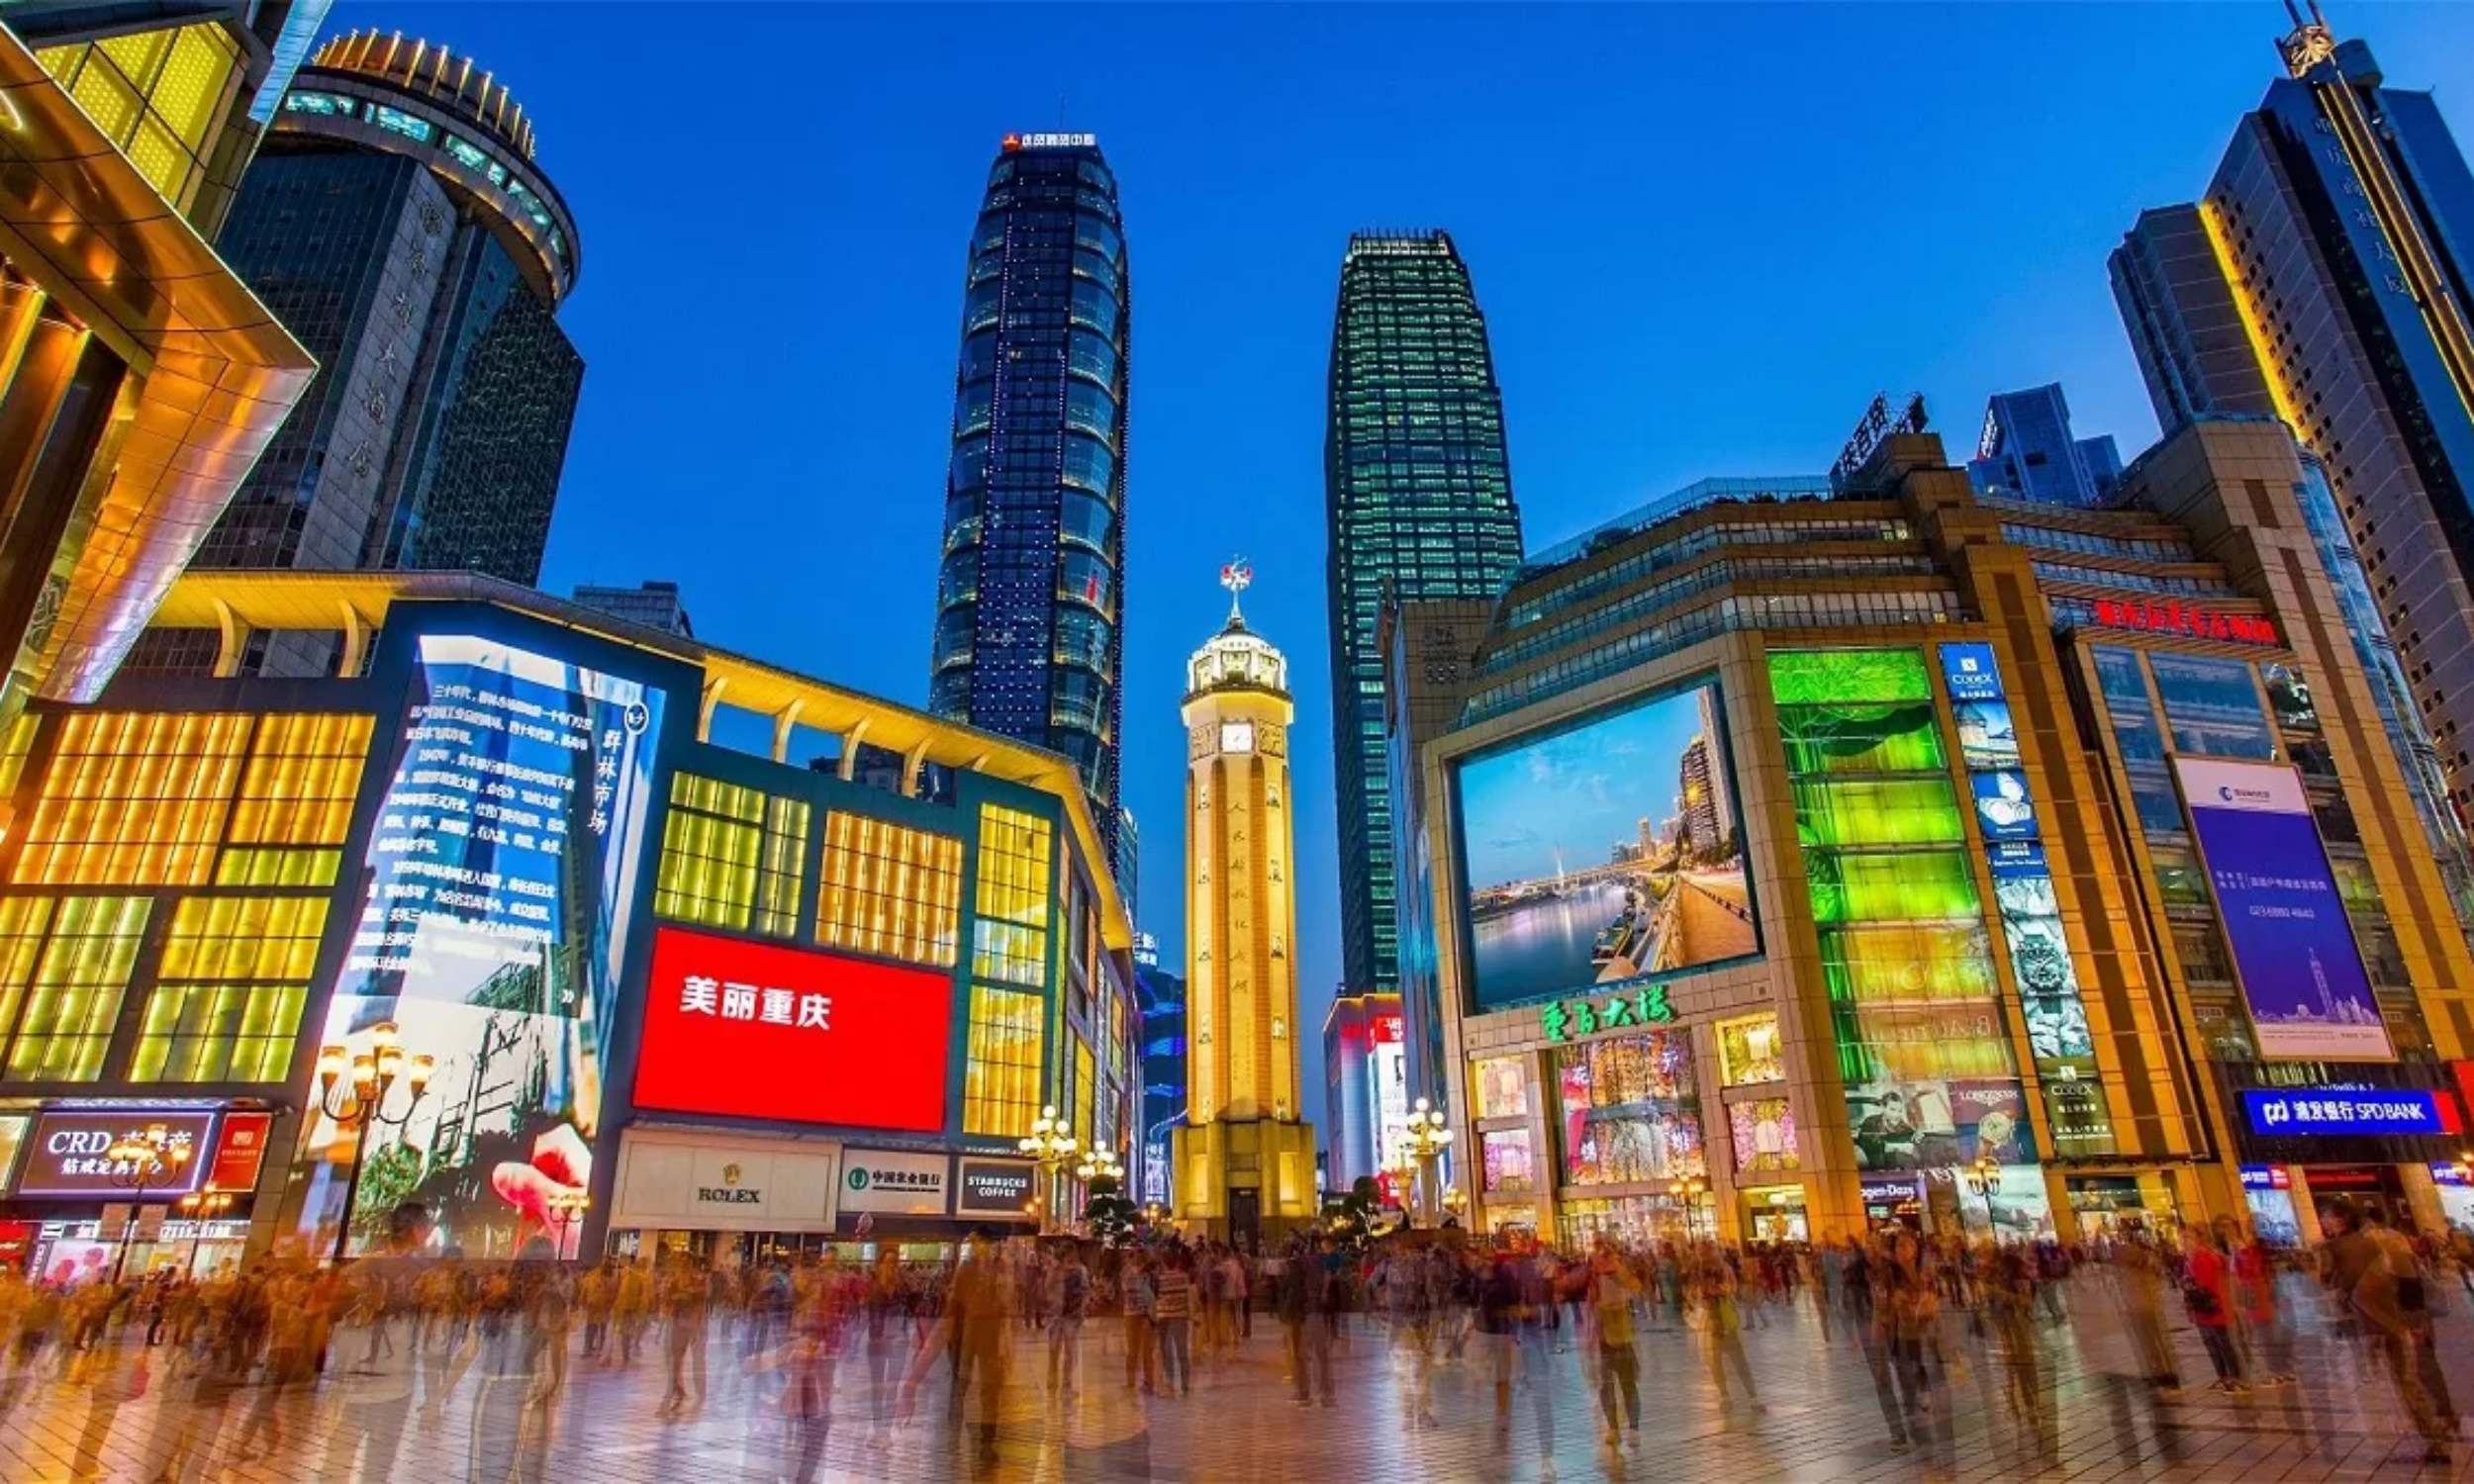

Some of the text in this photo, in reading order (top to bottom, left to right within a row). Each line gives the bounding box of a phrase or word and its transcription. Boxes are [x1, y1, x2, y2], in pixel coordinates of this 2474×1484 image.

[680, 974, 832, 1030] 美丽重庆
[2355, 1102, 2386, 1120] SPD
[2386, 1102, 2426, 1120] BANK
[48, 1132, 113, 1154] CRD
[872, 1169, 940, 1186] 中国农业银行
[968, 1175, 1027, 1187] STARBUCKS
[698, 1187, 761, 1204] ROLEX
[978, 1187, 1016, 1197] COFFEE
